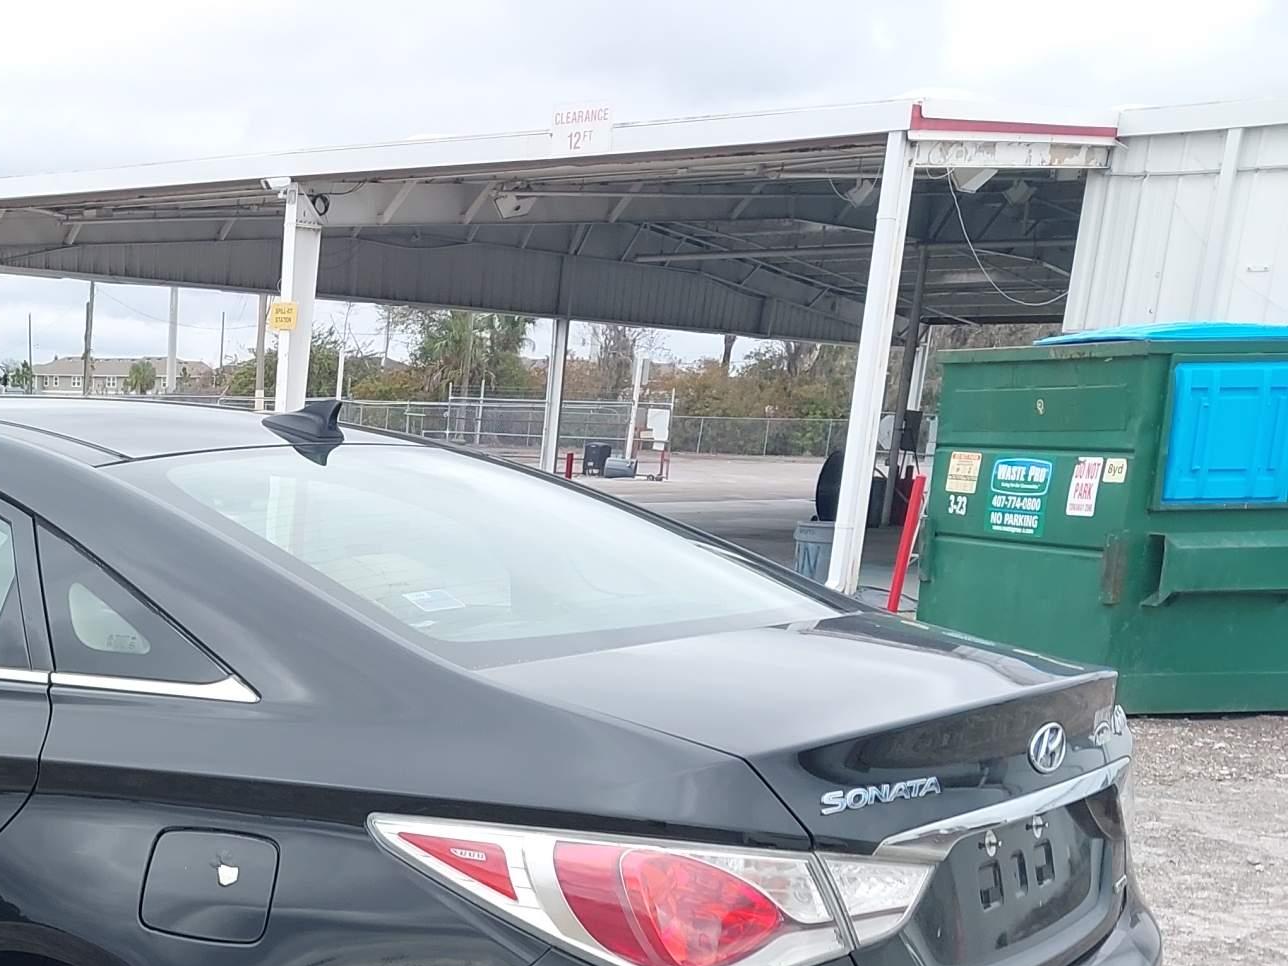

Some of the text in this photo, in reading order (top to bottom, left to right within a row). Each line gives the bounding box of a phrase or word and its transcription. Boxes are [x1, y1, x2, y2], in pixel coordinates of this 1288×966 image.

[555, 108, 608, 125] CLEARANCE
[568, 130, 593, 150] 12 FT
[997, 465, 1026, 481] WASTE
[1086, 462, 1100, 479] NOT
[1073, 482, 1094, 500] PARK
[948, 495, 967, 515] 3-23
[991, 494, 1042, 511] 407-774-0800
[990, 511, 1039, 529] NO PARKING
[820, 776, 943, 816] SONATA
